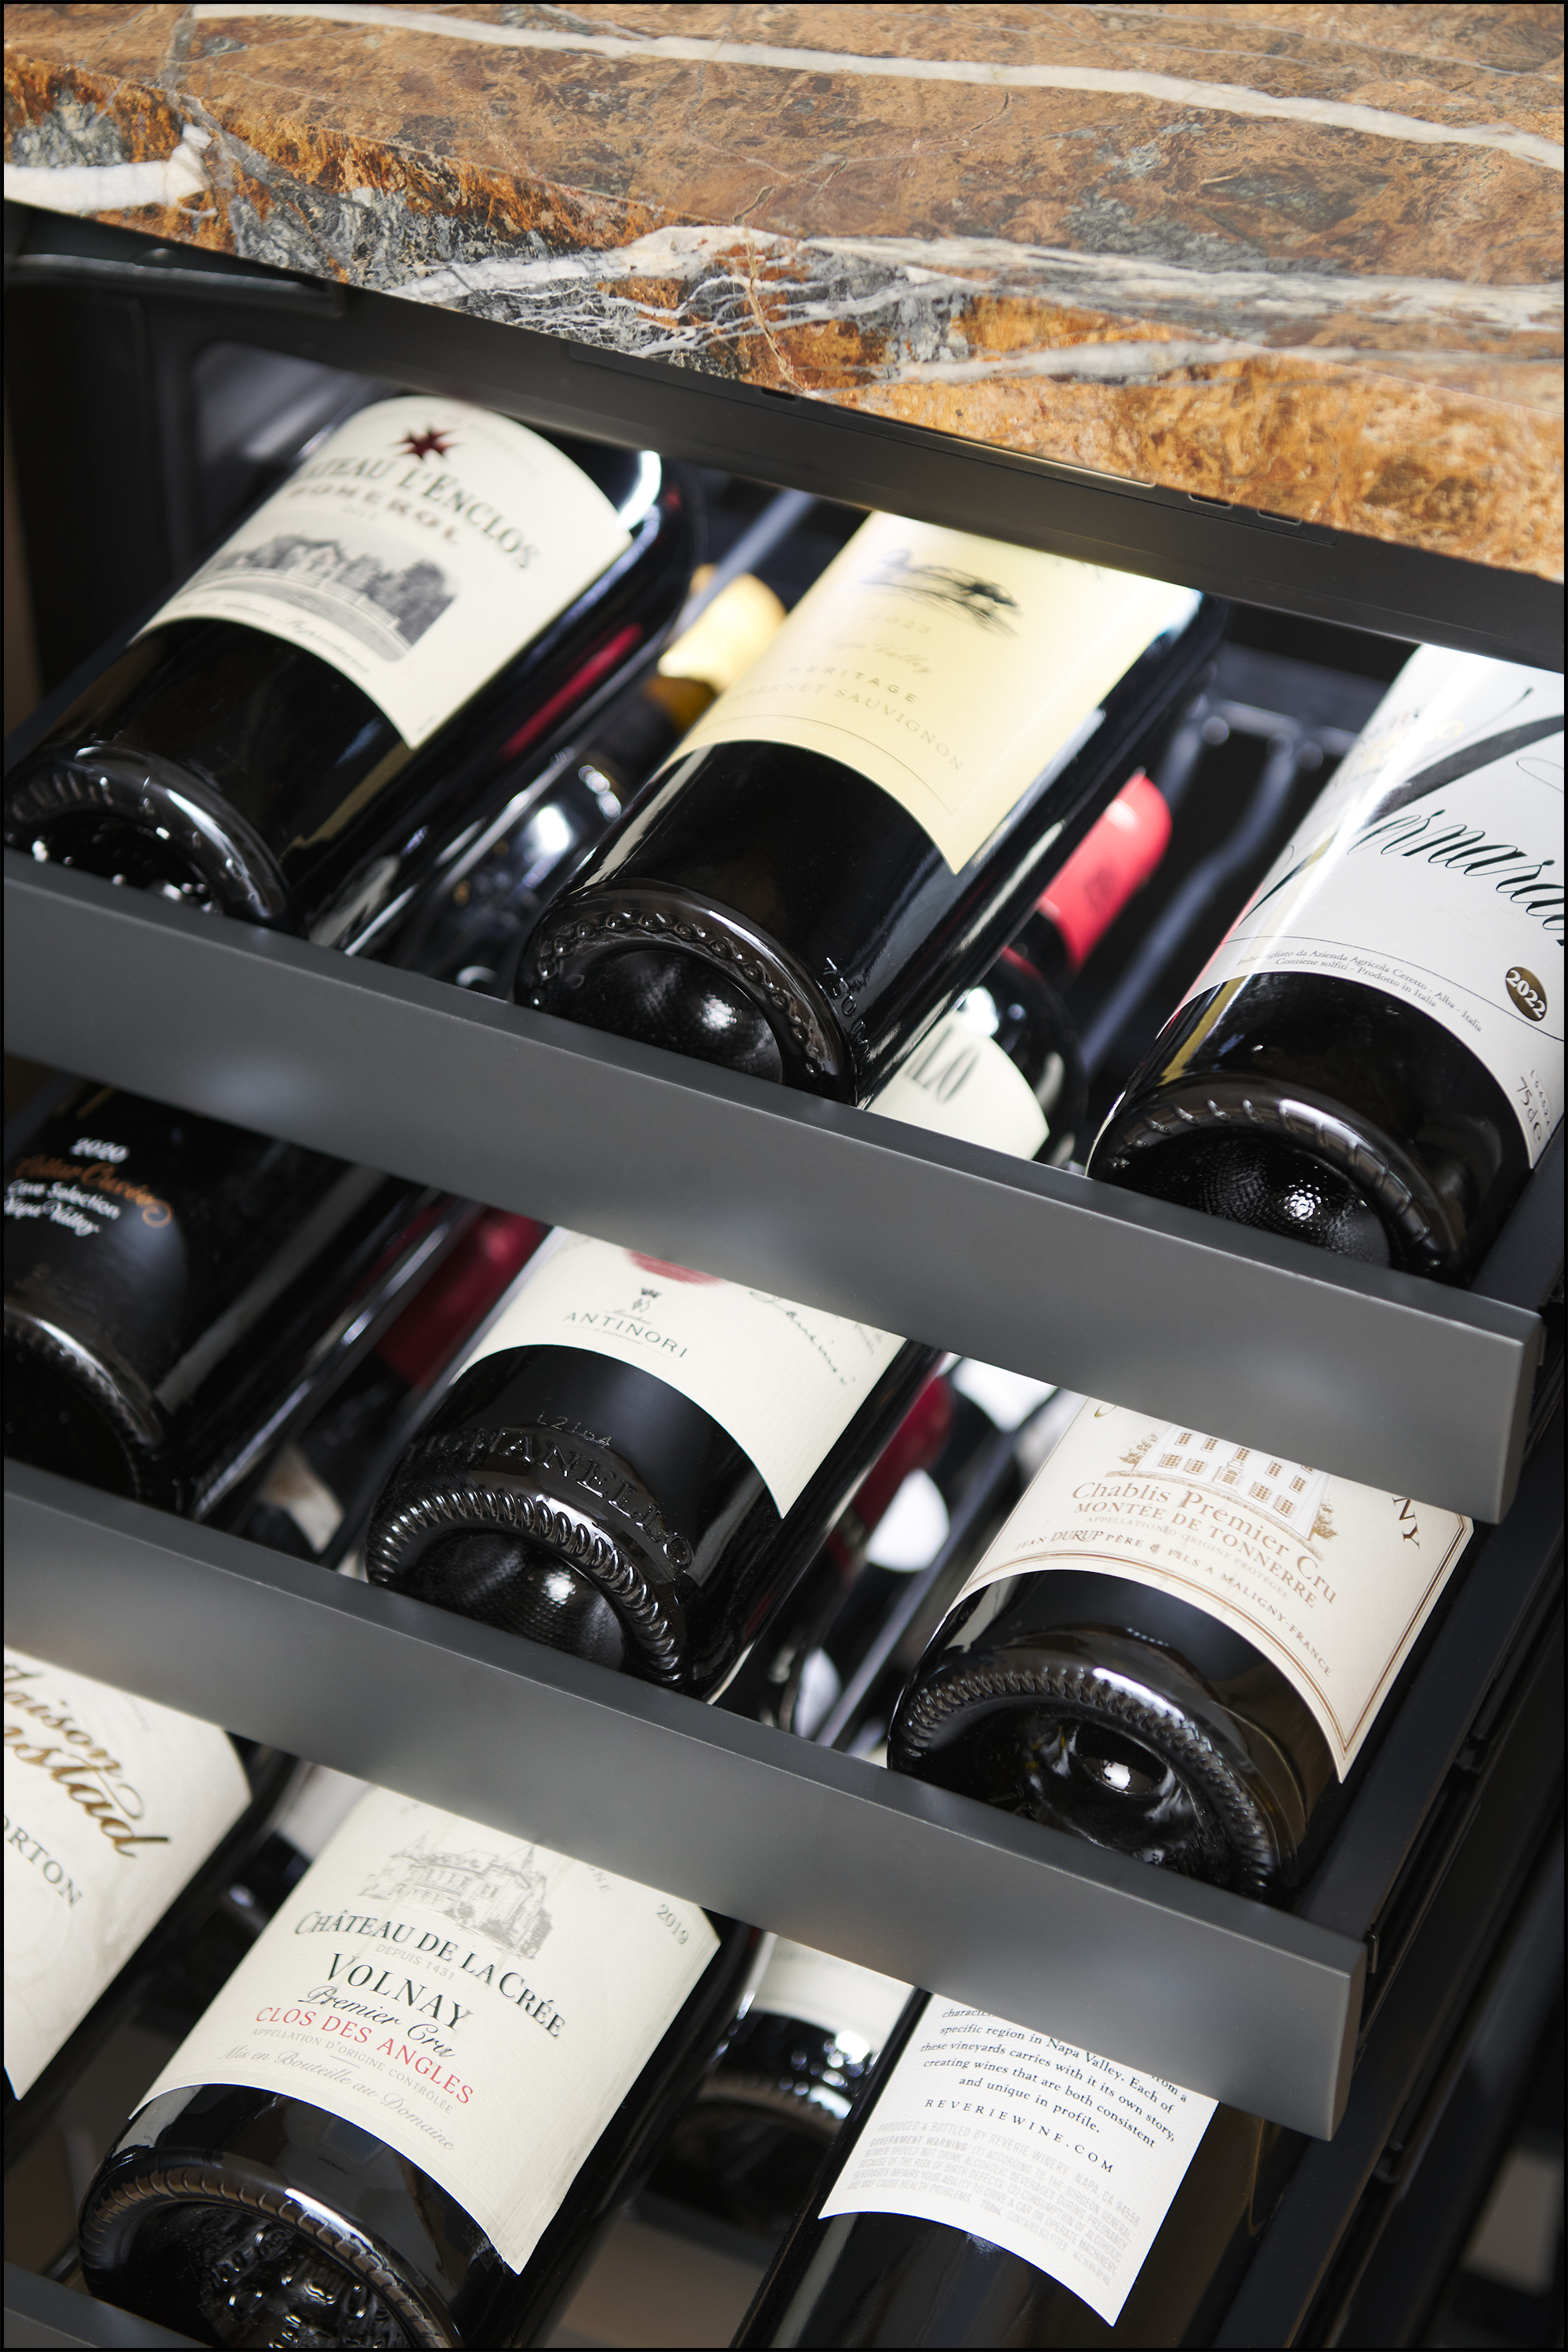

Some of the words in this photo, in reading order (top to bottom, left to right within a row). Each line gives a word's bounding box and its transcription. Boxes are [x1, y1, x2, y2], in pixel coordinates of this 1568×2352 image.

[396, 466, 540, 570] L'ENCLOS
[834, 688, 964, 770] SAUVIGNON
[1296, 949, 1308, 957] da
[1309, 950, 1348, 961] Azienda
[1349, 955, 1390, 973] Agricola
[1392, 967, 1428, 990] Ceretto
[1434, 992, 1456, 1010] Alba
[1461, 1011, 1483, 1033] Italia
[1320, 957, 1350, 971] solfiti
[1357, 967, 1400, 988] Prodotto
[1401, 983, 1413, 993] in
[1412, 988, 1438, 1008] Italia
[1506, 969, 1546, 1019] 2022
[562, 1312, 688, 1358] ANTINORI
[1072, 1482, 1171, 1504] Chablis
[1178, 1490, 1290, 1557] Premier
[1297, 1555, 1338, 1606] Cru
[1074, 1501, 1167, 1520] MONTÉE
[1172, 1512, 1202, 1532] DE
[1209, 1525, 1318, 1608] TONNERRE
[1014, 1535, 1047, 1552] JEAN
[1050, 1530, 1104, 1543] DURUP
[1167, 1548, 1201, 1567] FILS
[1220, 1572, 1332, 1677] MALIGNY-FRANCE
[375, 1944, 422, 1965] DEPUIS
[425, 1961, 456, 1980] 1431
[656, 1904, 689, 1945] 2019
[295, 1909, 417, 1944] CHÂTEAU
[415, 1931, 459, 1962] DE
[459, 1951, 496, 1987] LA
[499, 1971, 566, 2039] CRÉE
[327, 1952, 474, 2031] VOLNAY
[255, 2007, 317, 2027] CLOS
[321, 2015, 372, 2044] DES
[376, 2038, 474, 2104] ANGLES
[297, 1985, 401, 2026] Premier
[407, 2024, 456, 2058] Cru
[250, 2028, 321, 2045] APPELLATION
[325, 2040, 385, 2071] D'ORIGINE
[388, 2067, 453, 2114] CONTRÔLÉE
[252, 2051, 270, 2061] en
[274, 2051, 352, 2085] Bouteille
[352, 2082, 378, 2097] au
[380, 2092, 455, 2151] Domaine
[920, 2042, 947, 2052] these
[951, 2041, 1007, 2055] vineyards
[1010, 2049, 1051, 2067] carries
[1056, 2063, 1083, 2081] with
[1087, 2075, 1098, 2087] it
[1100, 2082, 1116, 2097] its
[1119, 2096, 1143, 2115] own
[1146, 2114, 1174, 2143] story,
[924, 2058, 971, 2070] creating
[974, 2061, 1009, 2074] wines
[1012, 2068, 1039, 2083] that
[1041, 2078, 1062, 2092] are
[1065, 2085, 1093, 2107] both
[1097, 2105, 1156, 2148] consistent
[940, 2023, 983, 2035] specific
[986, 2028, 1025, 2040] region
[1029, 2034, 1042, 2045] in
[1046, 2038, 1080, 2058] Napa
[1086, 2052, 1124, 2082] Valley.
[1129, 2076, 1158, 2103] Each
[1160, 2102, 1174, 2114] of
[959, 2078, 984, 2087] and
[987, 2082, 1031, 2100] unique
[1035, 2095, 1048, 2107] in
[1053, 2105, 1100, 2133] profile.
[869, 2136, 924, 2147] GOVERNMENT
[971, 2144, 985, 2157] (1)
[986, 2151, 1033, 2174] ACCORDING
[1035, 2169, 1046, 2181] TO
[1048, 2175, 1065, 2191] THE
[1065, 2186, 1101, 2215] SURGEON
[877, 2121, 920, 2133] PRODUCED
[921, 2122, 927, 2131] &
[931, 2122, 971, 2136] BOTTLED
[973, 2129, 988, 2140] BY
[989, 2133, 1030, 2157] REVERIE
[1032, 2149, 1070, 2176] WINERY
[1102, 2190, 1114, 2205] CA
[1116, 2201, 1141, 2228] 94558
[924, 2099, 1114, 2173] REVERIEWINE.COM
[858, 2157, 887, 2169] BECAUSE
[887, 2157, 899, 2166] OF
[900, 2158, 914, 2167] THE
[914, 2158, 931, 2169] RISK
[932, 2161, 944, 2170] OF
[944, 2163, 968, 2177] BIRTH
[1007, 2180, 1021, 2197] (2)
[1021, 2190, 1075, 2227] CONSUMPTION
[1075, 2221, 1087, 2234] OF
[1086, 2230, 1123, 2263] ALCOHOLIC
[864, 2147, 889, 2158] WOMEN
[890, 2146, 920, 2156] SHOULD
[921, 2147, 937, 2158] NOT
[938, 2150, 964, 2163] DRINK
[964, 2155, 1008, 2177] ALCOHOLIC
[1009, 2172, 1056, 2200] BEVERAGES
[1056, 2194, 1084, 2220] DURING
[1087, 2213, 1128, 2252] PREGNANCY
[889, 2168, 920, 2179] IMPAIRS
[921, 2171, 942, 2183] YOUR
[942, 2175, 972, 2190] ABILITY
[973, 2183, 985, 2194] TO
[984, 2187, 1008, 2205] DRIVE
[1007, 2198, 1015, 2208] A
[1016, 2201, 1033, 2216] CAR
[1033, 2210, 1045, 2223] OR
[1045, 2216, 1080, 2245] OPERATE
[901, 2180, 928, 2192] HEALTH
[1007, 2211, 1039, 2234] CONTAINS
[1038, 2227, 1069, 2252] SULFITES
